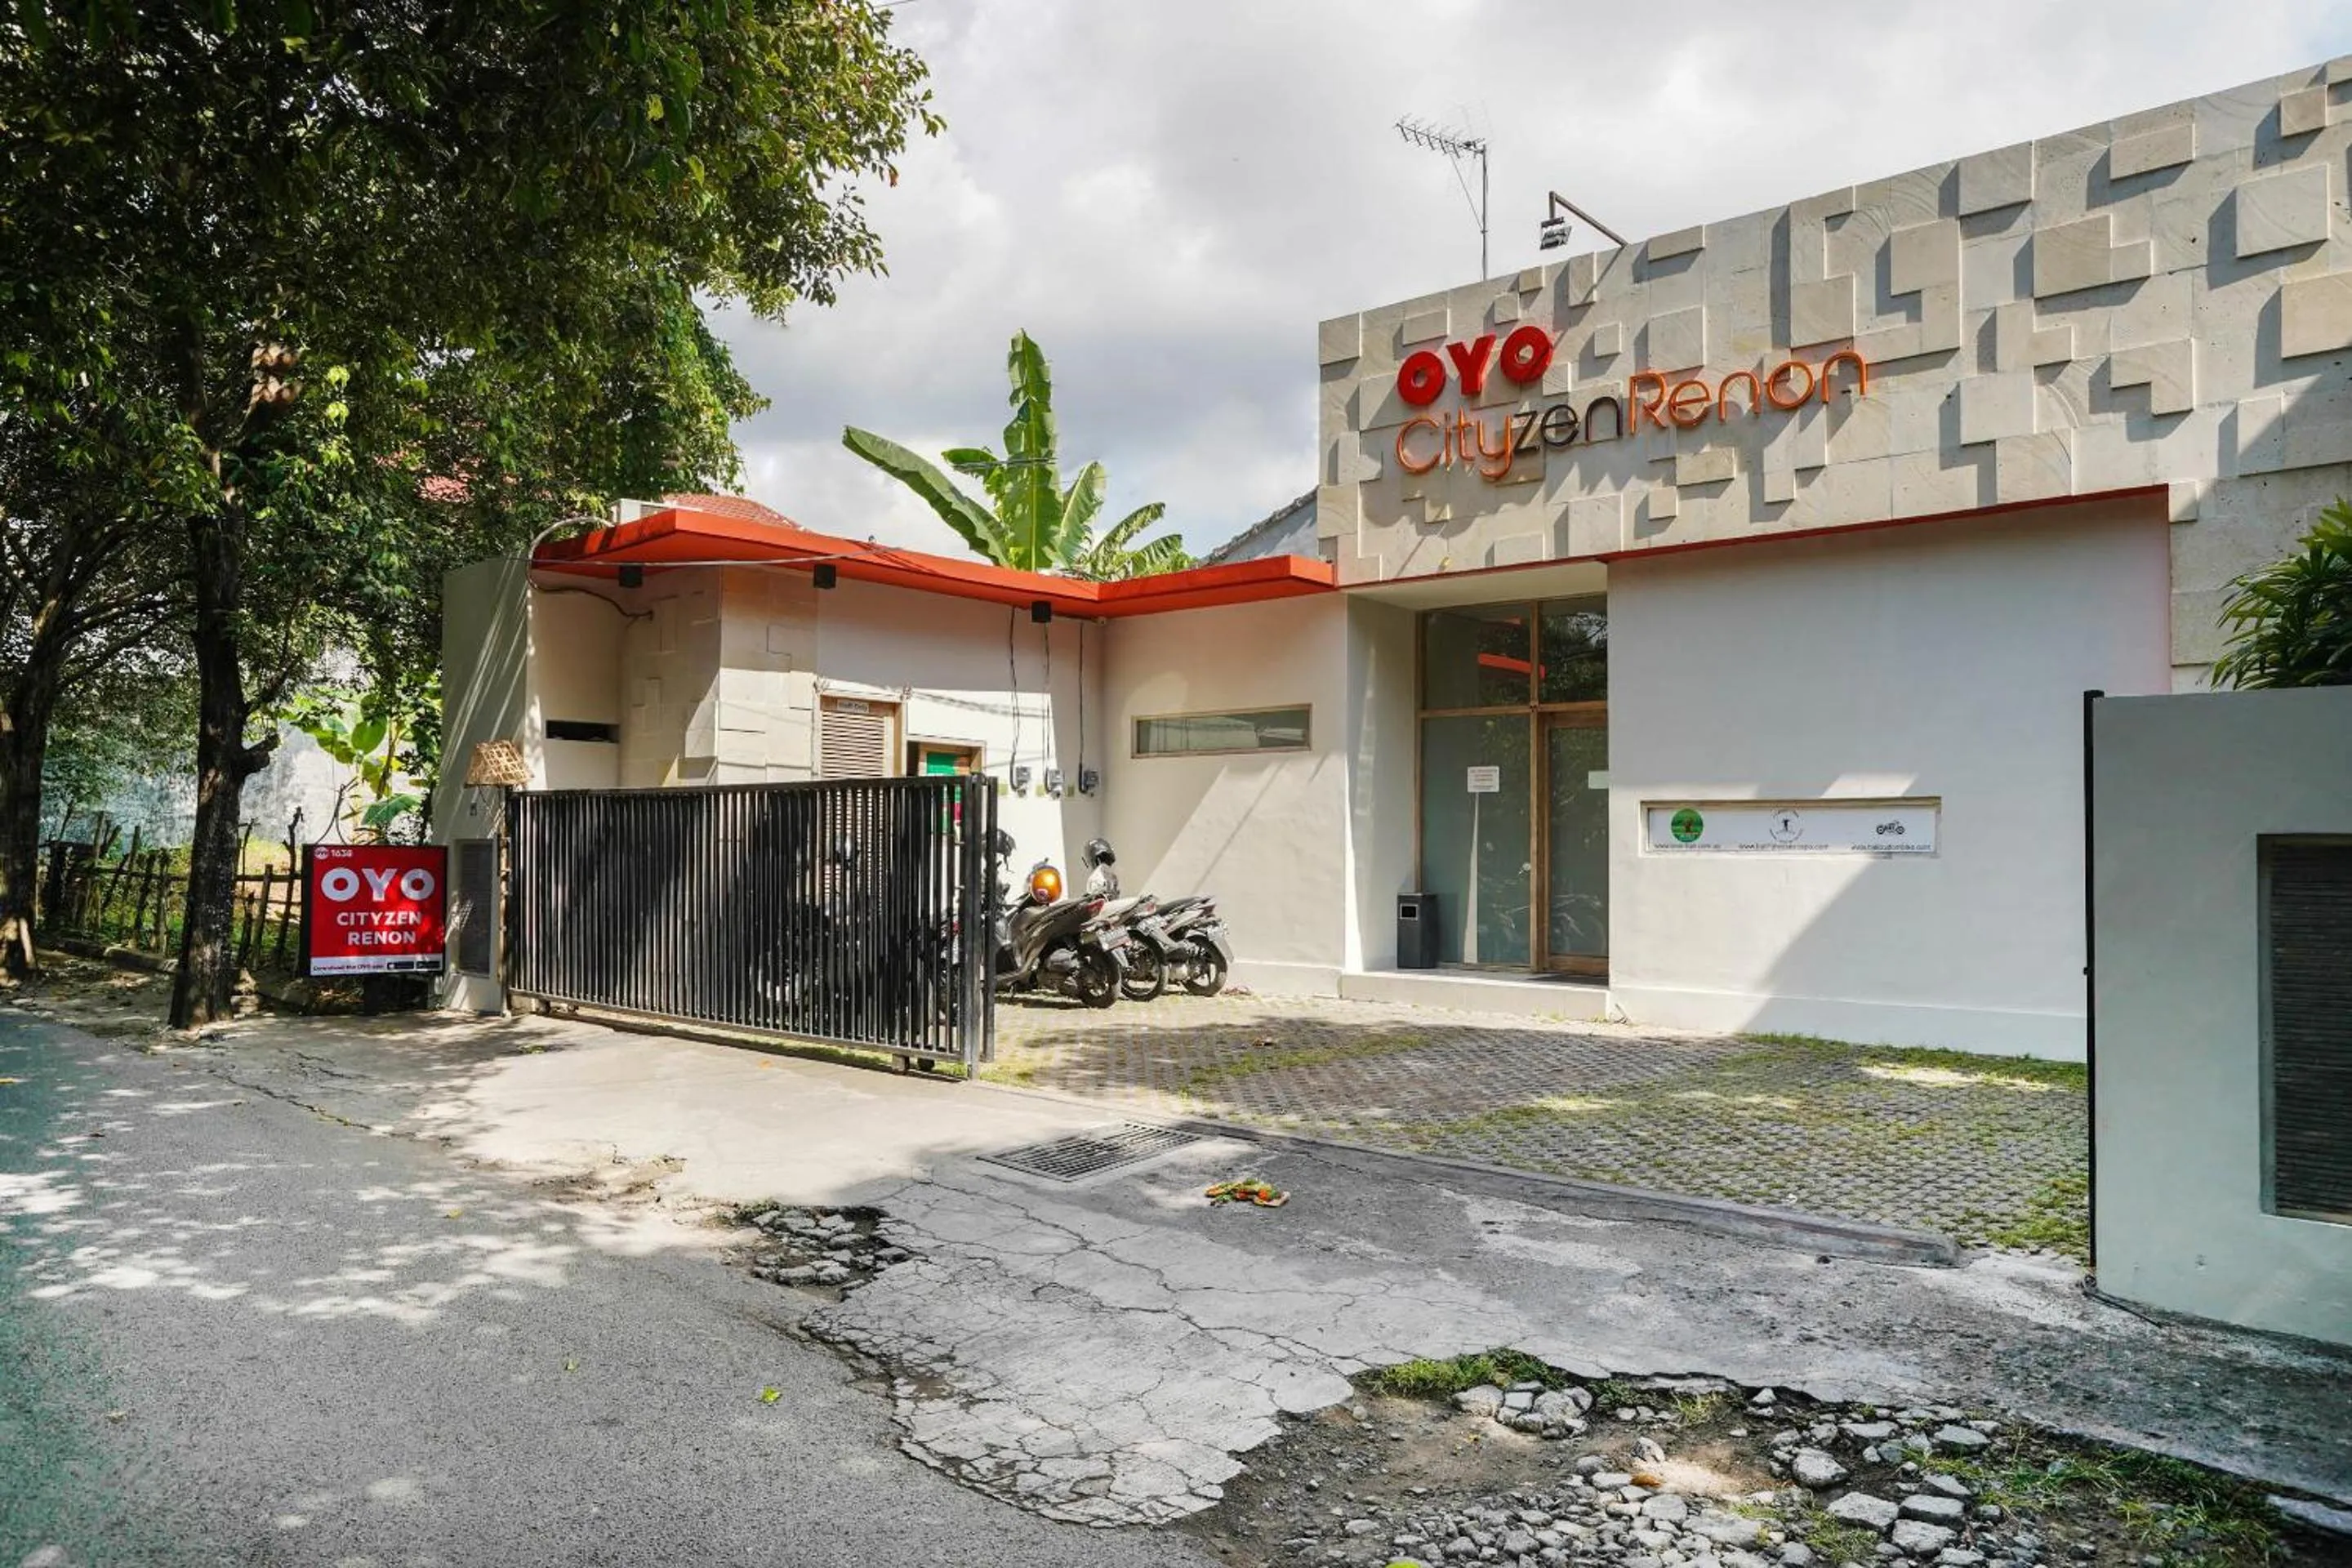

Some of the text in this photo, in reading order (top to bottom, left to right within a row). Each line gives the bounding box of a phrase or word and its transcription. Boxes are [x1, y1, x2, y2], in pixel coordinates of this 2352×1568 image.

[1397, 326, 1551, 405] OYO
[321, 867, 434, 902] OYO
[336, 911, 422, 926] CITYZEN
[348, 931, 416, 946] RENON
